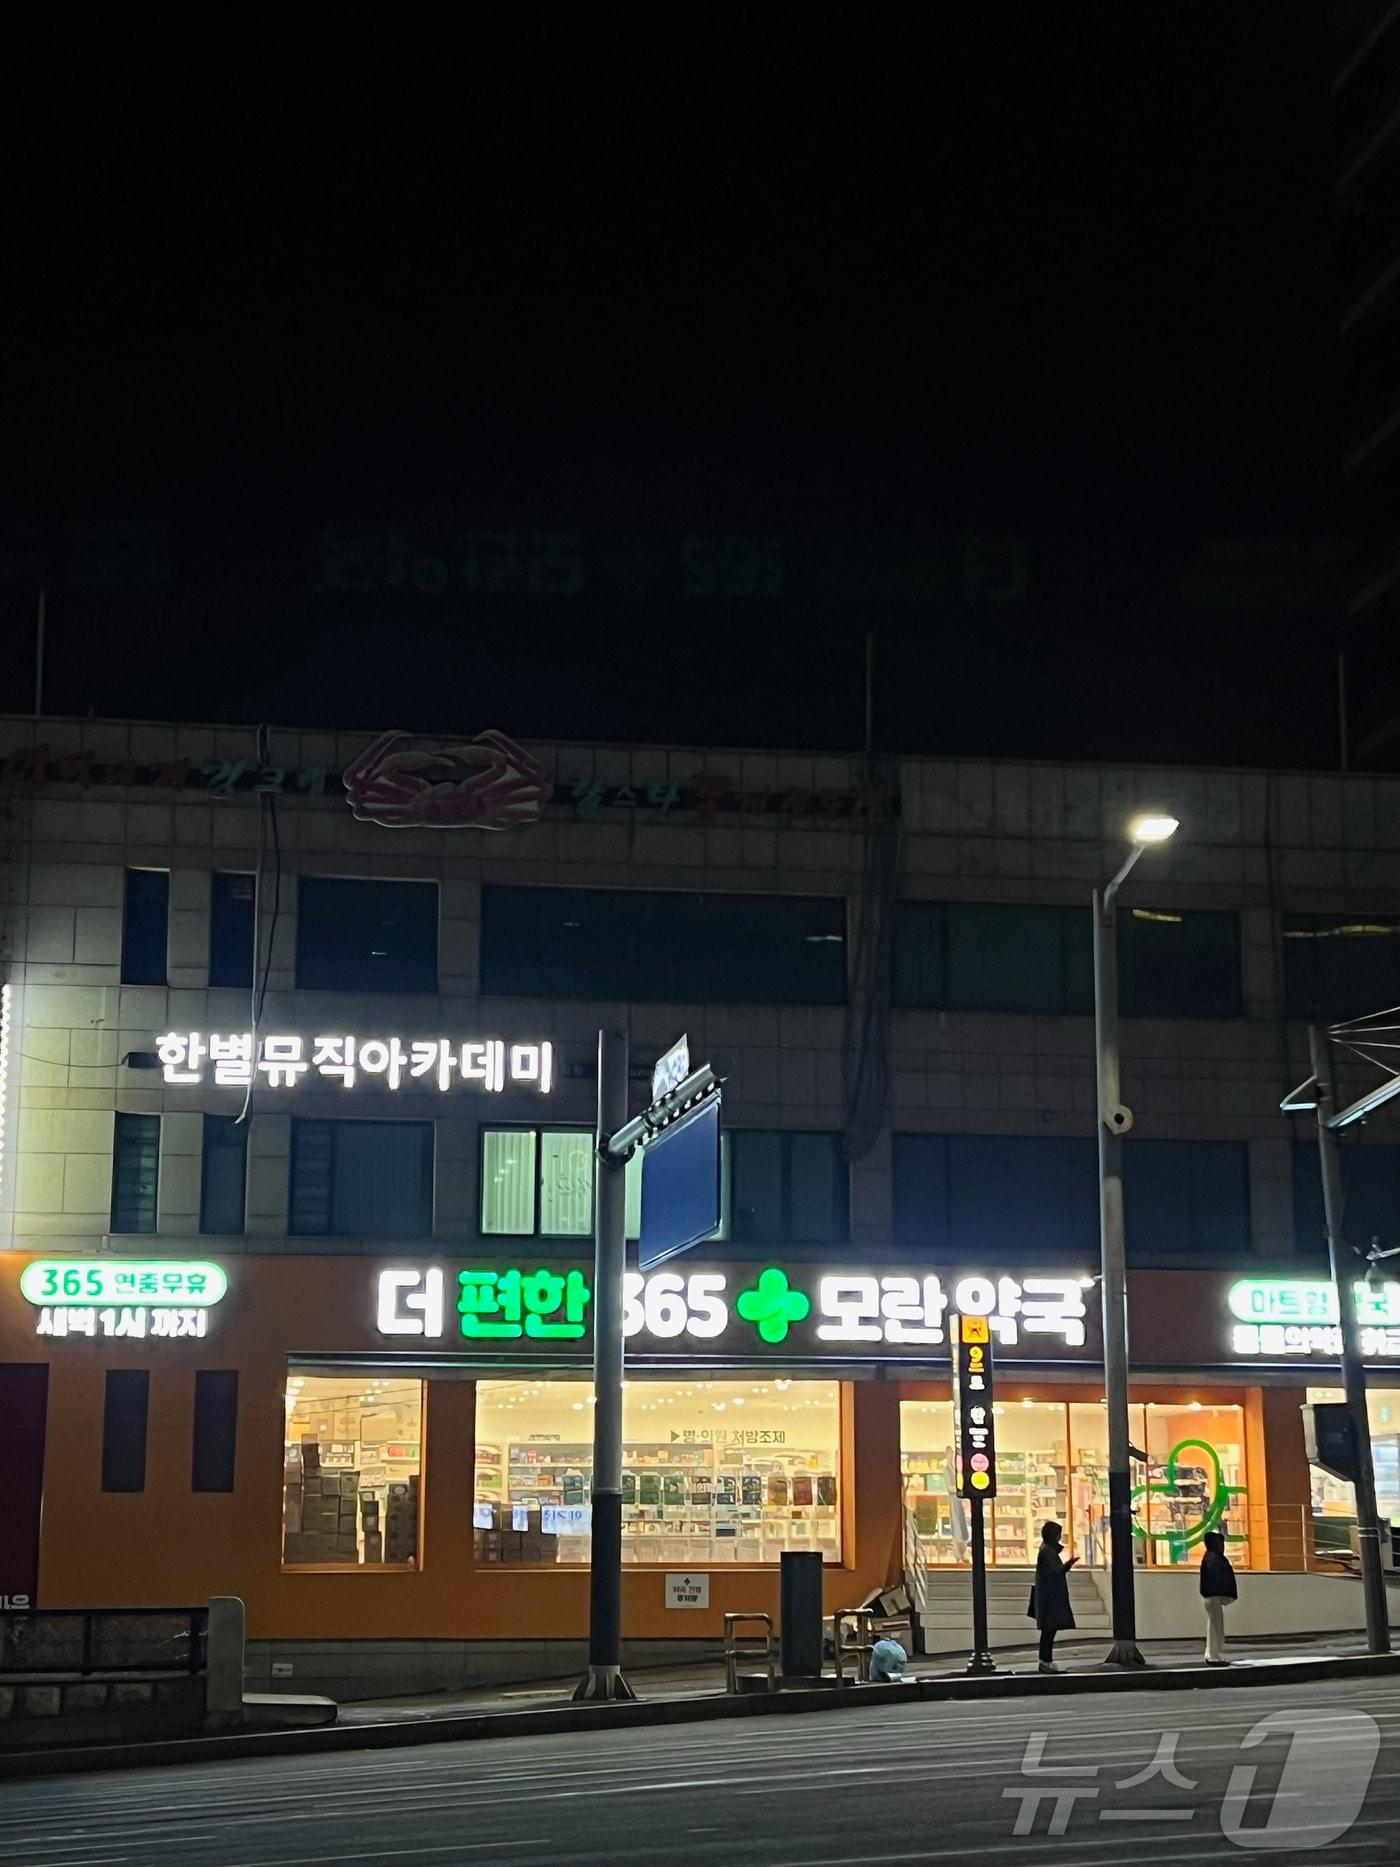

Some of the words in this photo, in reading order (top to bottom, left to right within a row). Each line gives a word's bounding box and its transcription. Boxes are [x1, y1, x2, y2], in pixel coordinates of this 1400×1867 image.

[155, 1031, 553, 1094] 한별뮤직아카데미
[40, 1269, 104, 1297] 365
[114, 1272, 208, 1295] 연중무휴
[378, 1269, 443, 1337] 더
[458, 1270, 590, 1337] 편한
[1250, 1288, 1329, 1316] 마트형
[36, 1307, 96, 1336] 새벽
[99, 1307, 147, 1338] 1시
[151, 1308, 207, 1338] 까지
[732, 1429, 786, 1446] 처방조제
